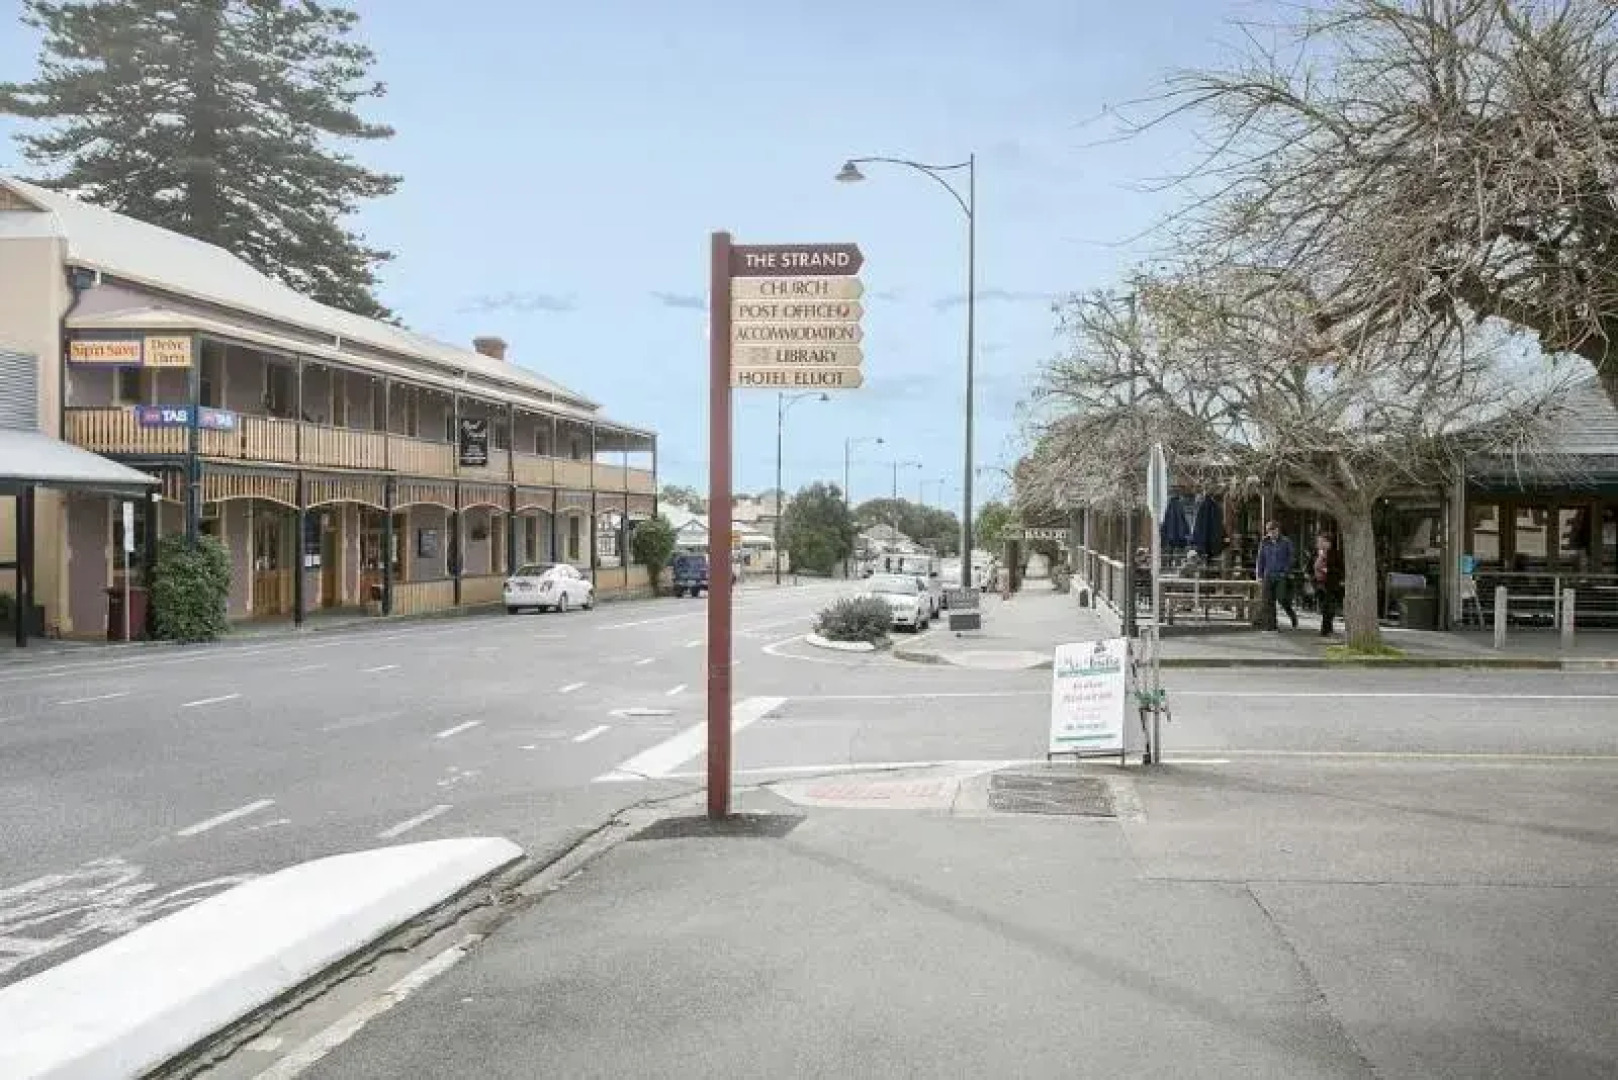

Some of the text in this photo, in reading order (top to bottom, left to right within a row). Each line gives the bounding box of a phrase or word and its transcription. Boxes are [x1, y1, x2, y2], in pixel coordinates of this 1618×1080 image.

[746, 252, 850, 268] THE STRAND
[760, 280, 829, 295] CHURCH
[739, 304, 837, 318] POST OFFICE
[737, 327, 855, 341] ACCOMMODATION
[776, 349, 838, 363] LIBRARY
[738, 371, 844, 385] HOTEL ELLIOT
[161, 410, 188, 422] TAB
